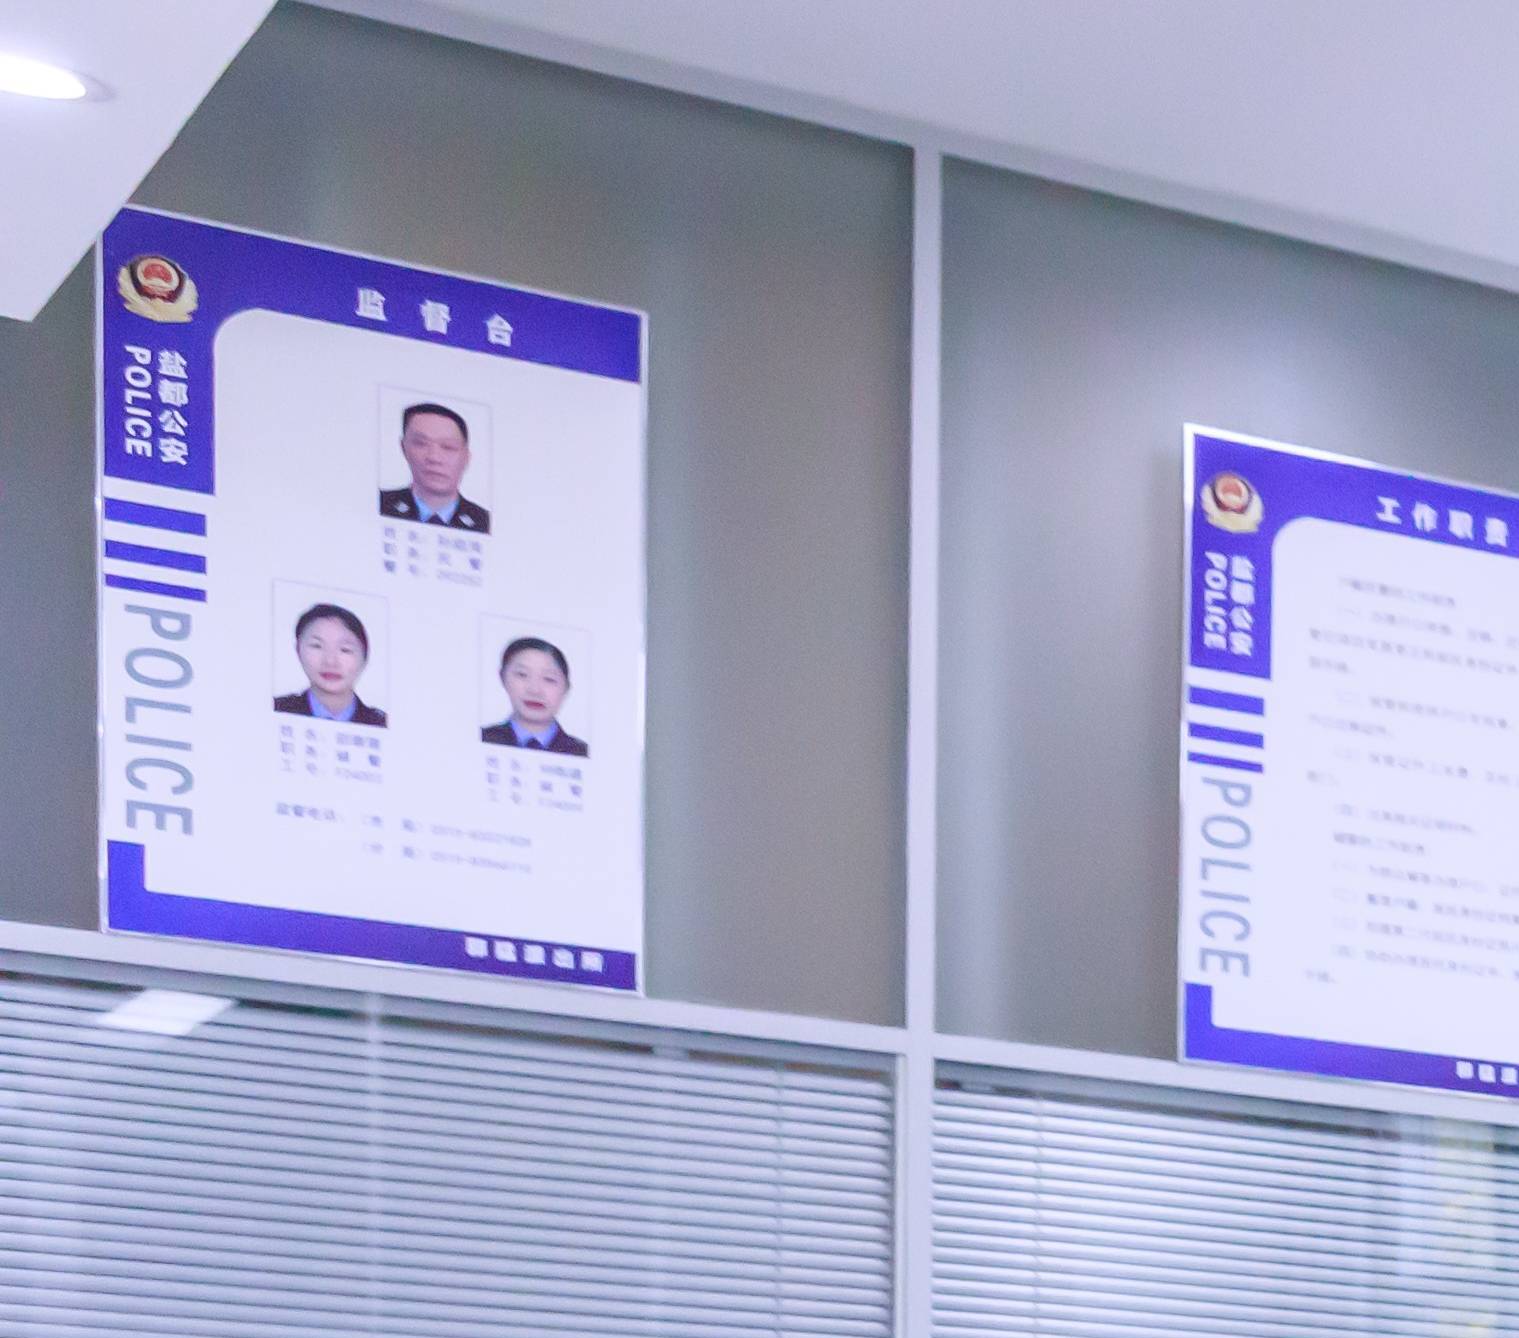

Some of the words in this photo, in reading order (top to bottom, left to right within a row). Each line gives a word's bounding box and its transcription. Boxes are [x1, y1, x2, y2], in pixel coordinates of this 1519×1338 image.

[355, 287, 514, 348] 监督台
[124, 345, 153, 458] POLICE
[1203, 551, 1228, 651] POLICE
[125, 603, 194, 836] POLICE
[1198, 775, 1254, 980] POLICE
